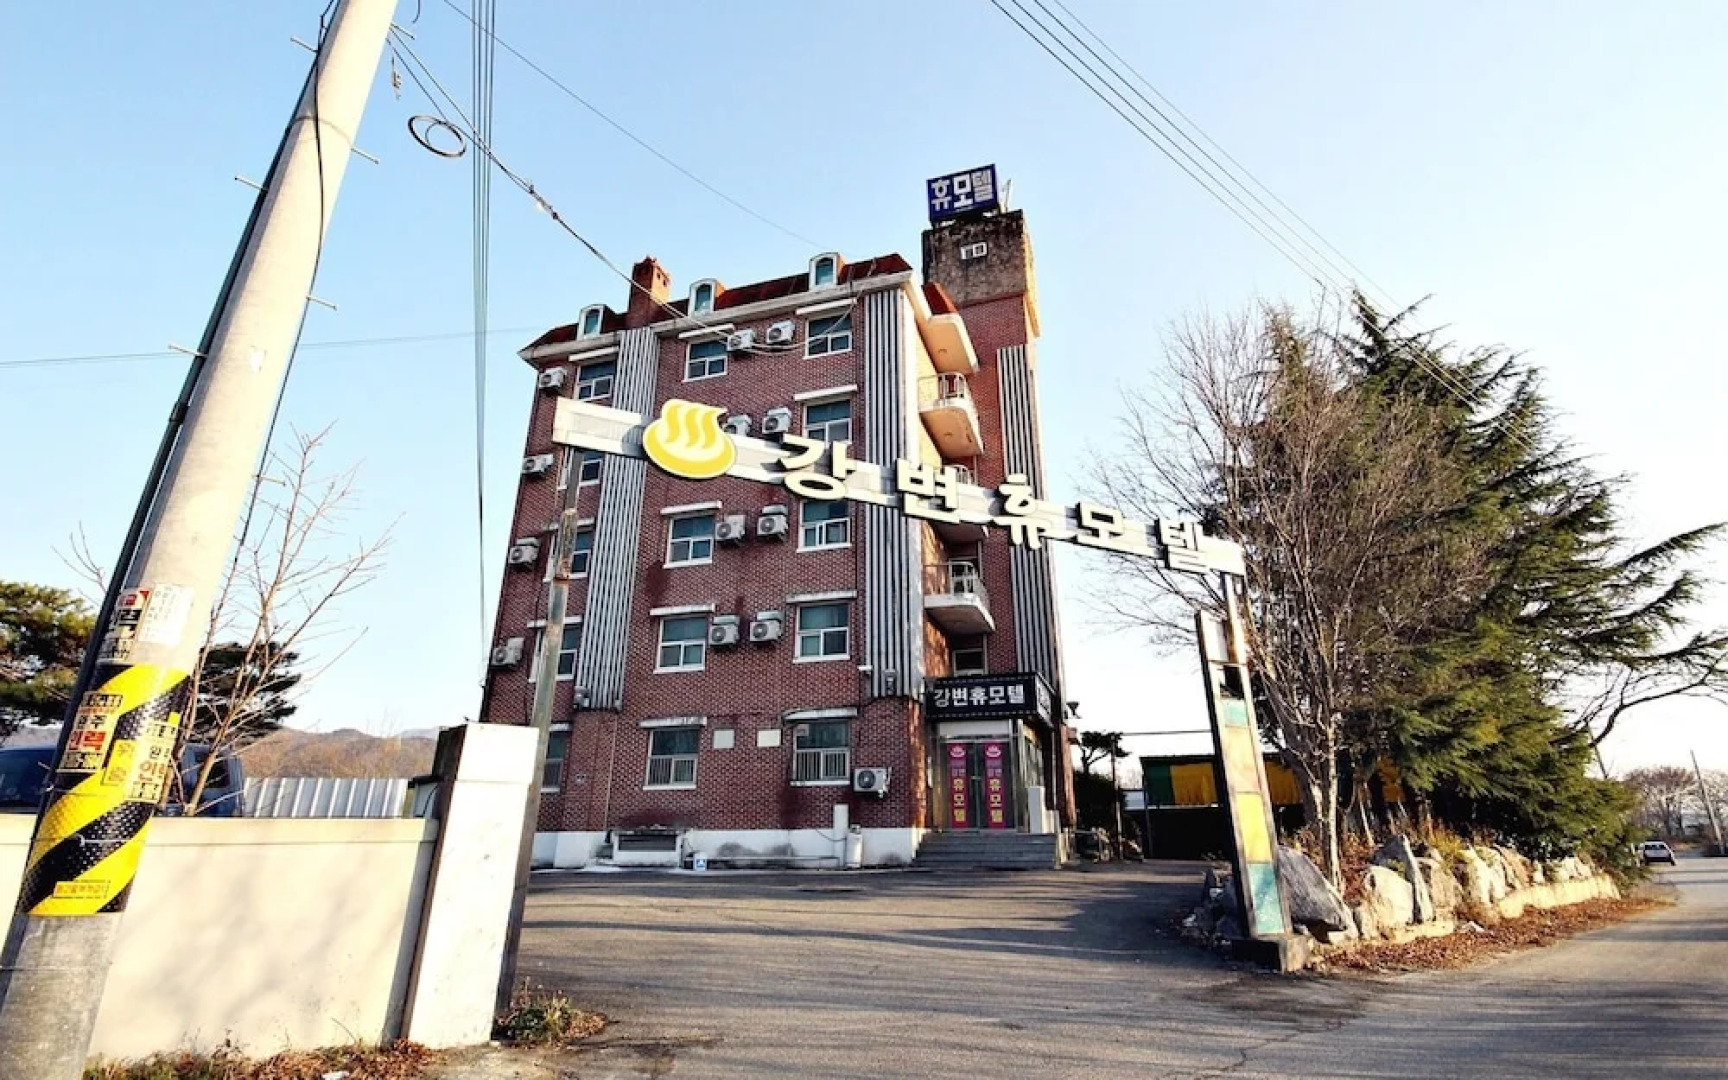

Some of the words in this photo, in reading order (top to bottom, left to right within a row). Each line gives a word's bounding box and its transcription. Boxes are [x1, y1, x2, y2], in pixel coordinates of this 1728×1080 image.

[931, 169, 995, 211] 휴모텔
[780, 433, 1211, 574] 강변휴모텔
[933, 684, 1026, 708] 강변휴모텔
